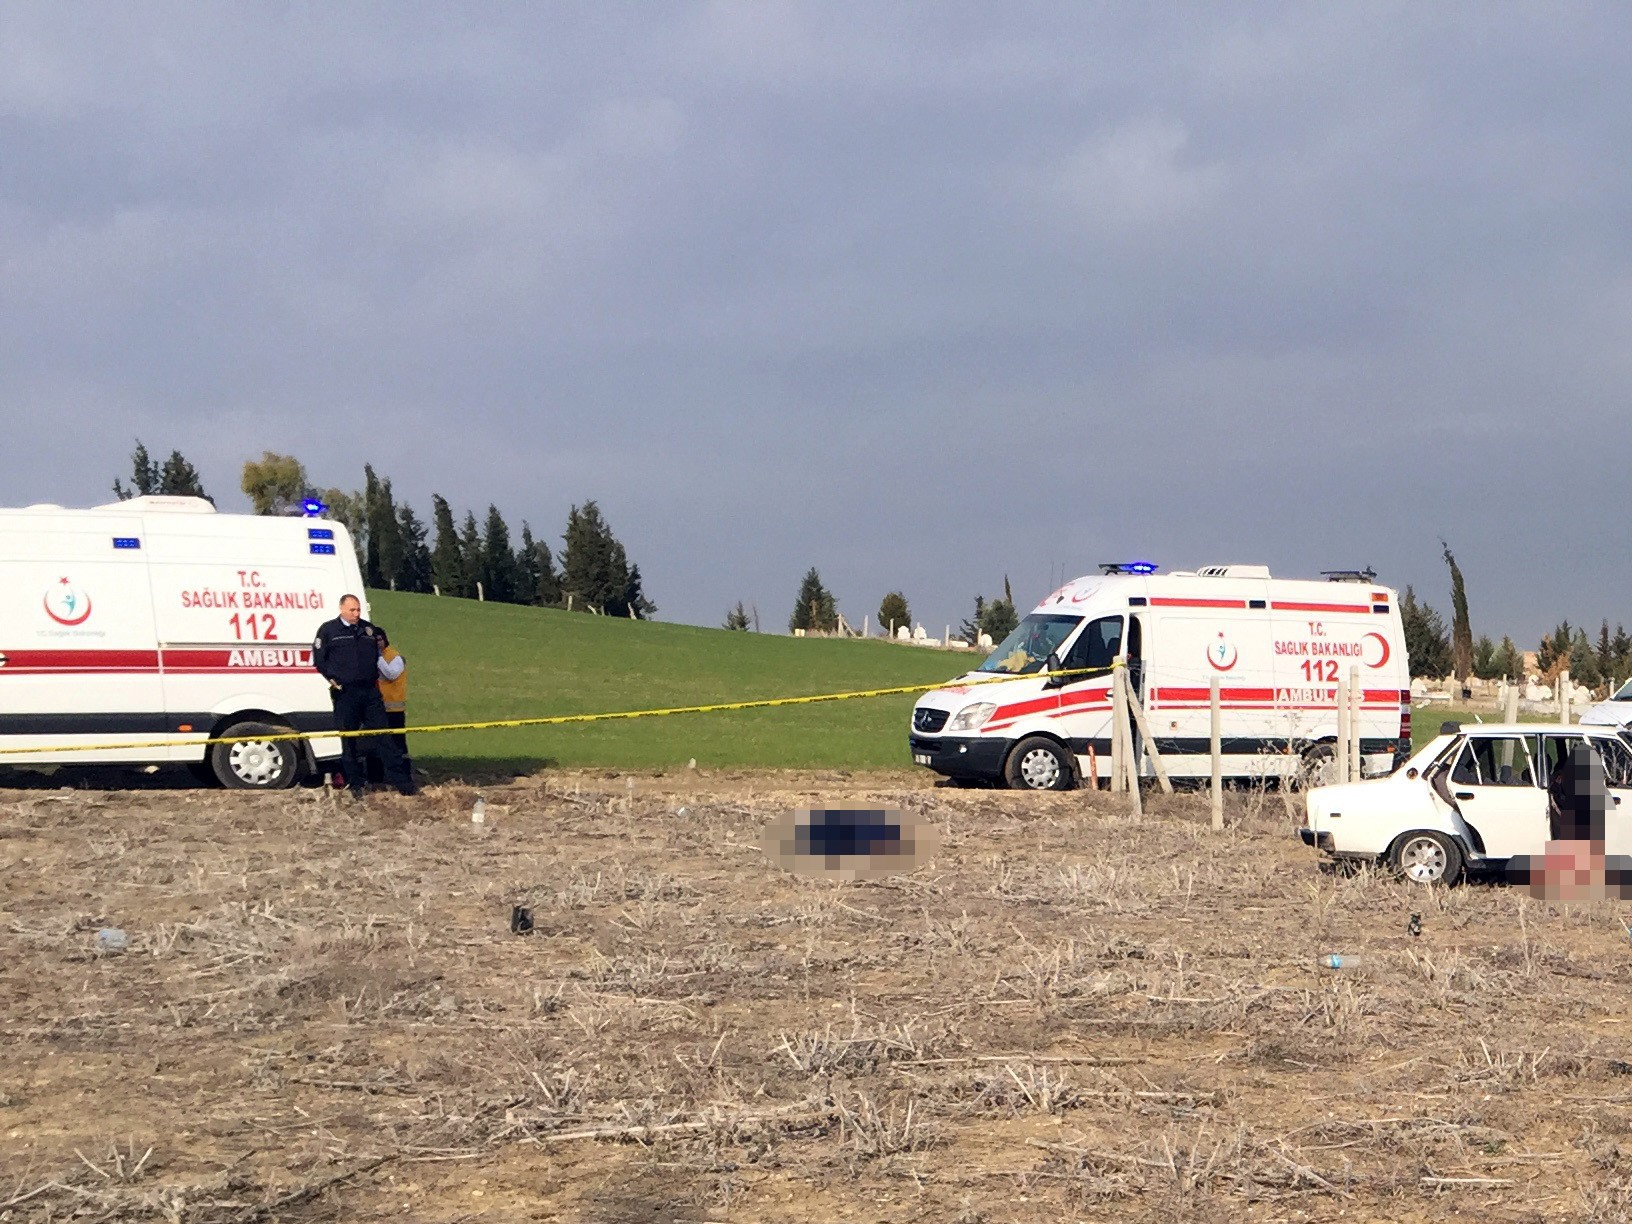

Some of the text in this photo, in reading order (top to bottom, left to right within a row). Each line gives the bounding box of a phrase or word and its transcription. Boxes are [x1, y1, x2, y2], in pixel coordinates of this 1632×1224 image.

[237, 571, 266, 588] T.C.
[181, 587, 324, 609] SAĞLIK BAKANLIĞI
[229, 612, 278, 640] 112
[1308, 621, 1327, 636] T.C.
[1301, 659, 1339, 682] 112
